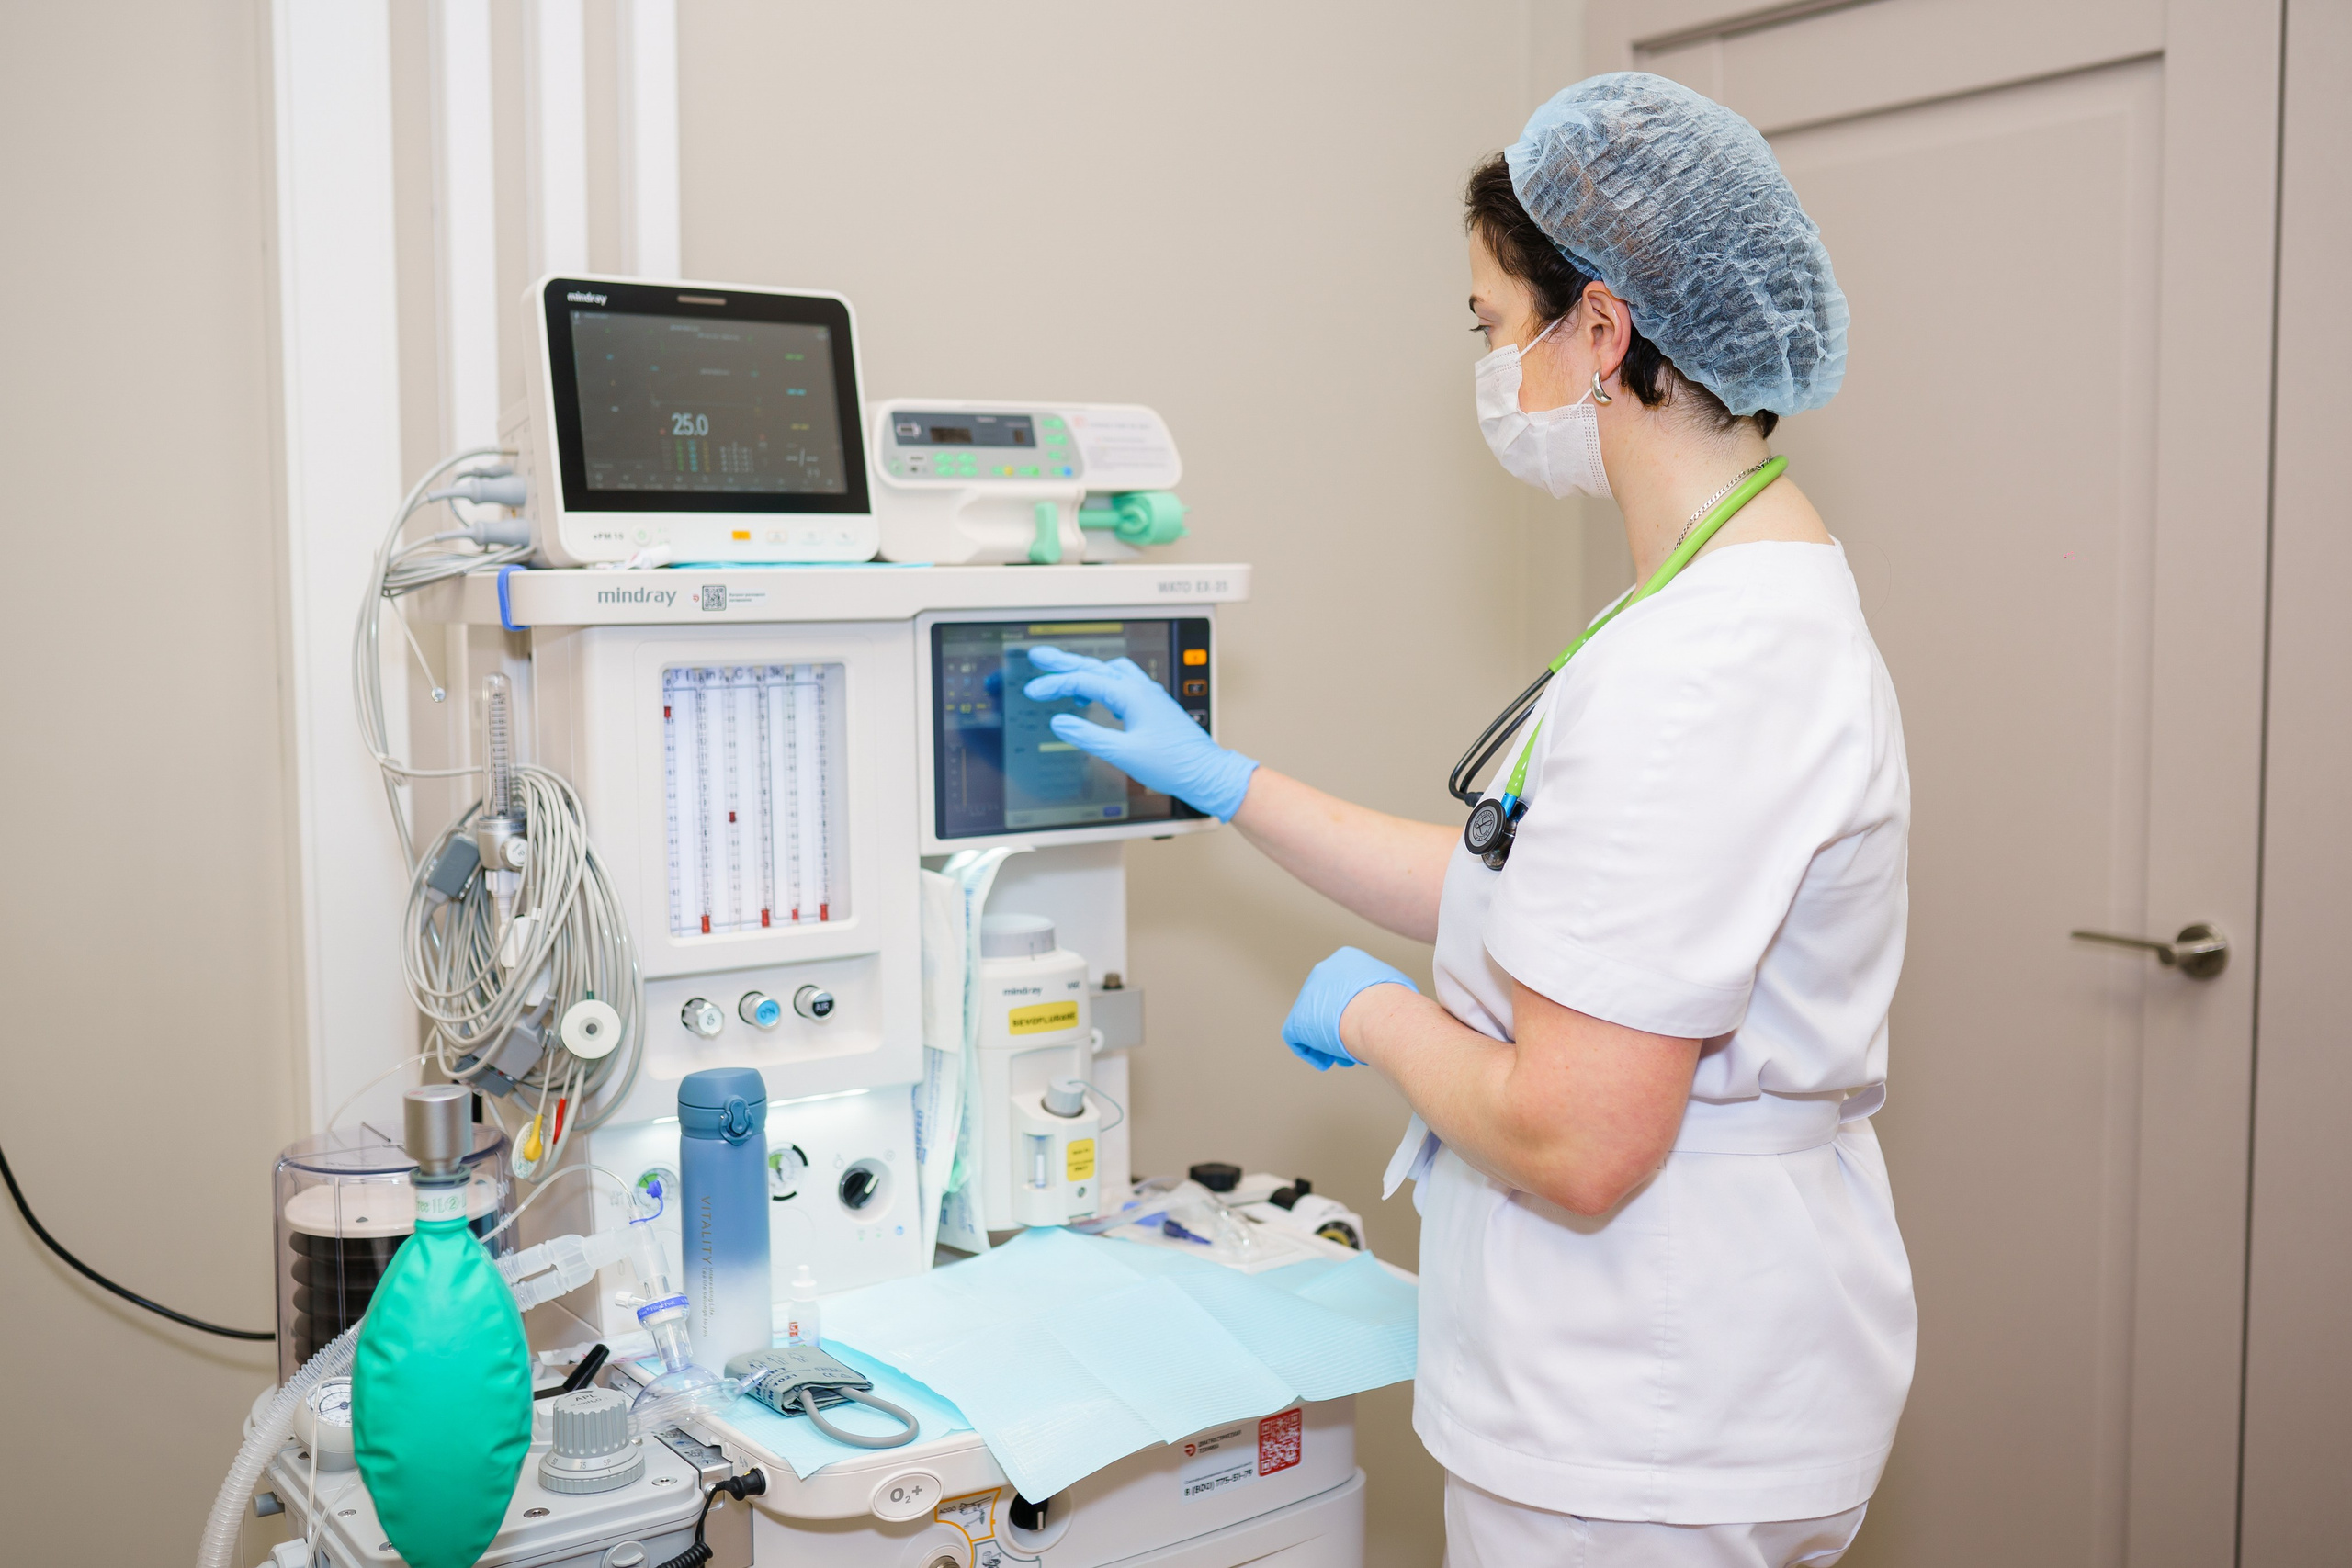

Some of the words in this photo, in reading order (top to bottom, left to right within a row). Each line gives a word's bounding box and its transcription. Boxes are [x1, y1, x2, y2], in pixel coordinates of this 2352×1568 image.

[567, 290, 608, 306] mindray
[671, 412, 709, 436] 25.0
[597, 587, 677, 607] mindray
[816, 1002, 830, 1012] AIR
[701, 1195, 712, 1265] VITALITY
[579, 1461, 587, 1470] 75
[603, 1458, 612, 1467] SP
[1183, 1488, 1191, 1497] 8
